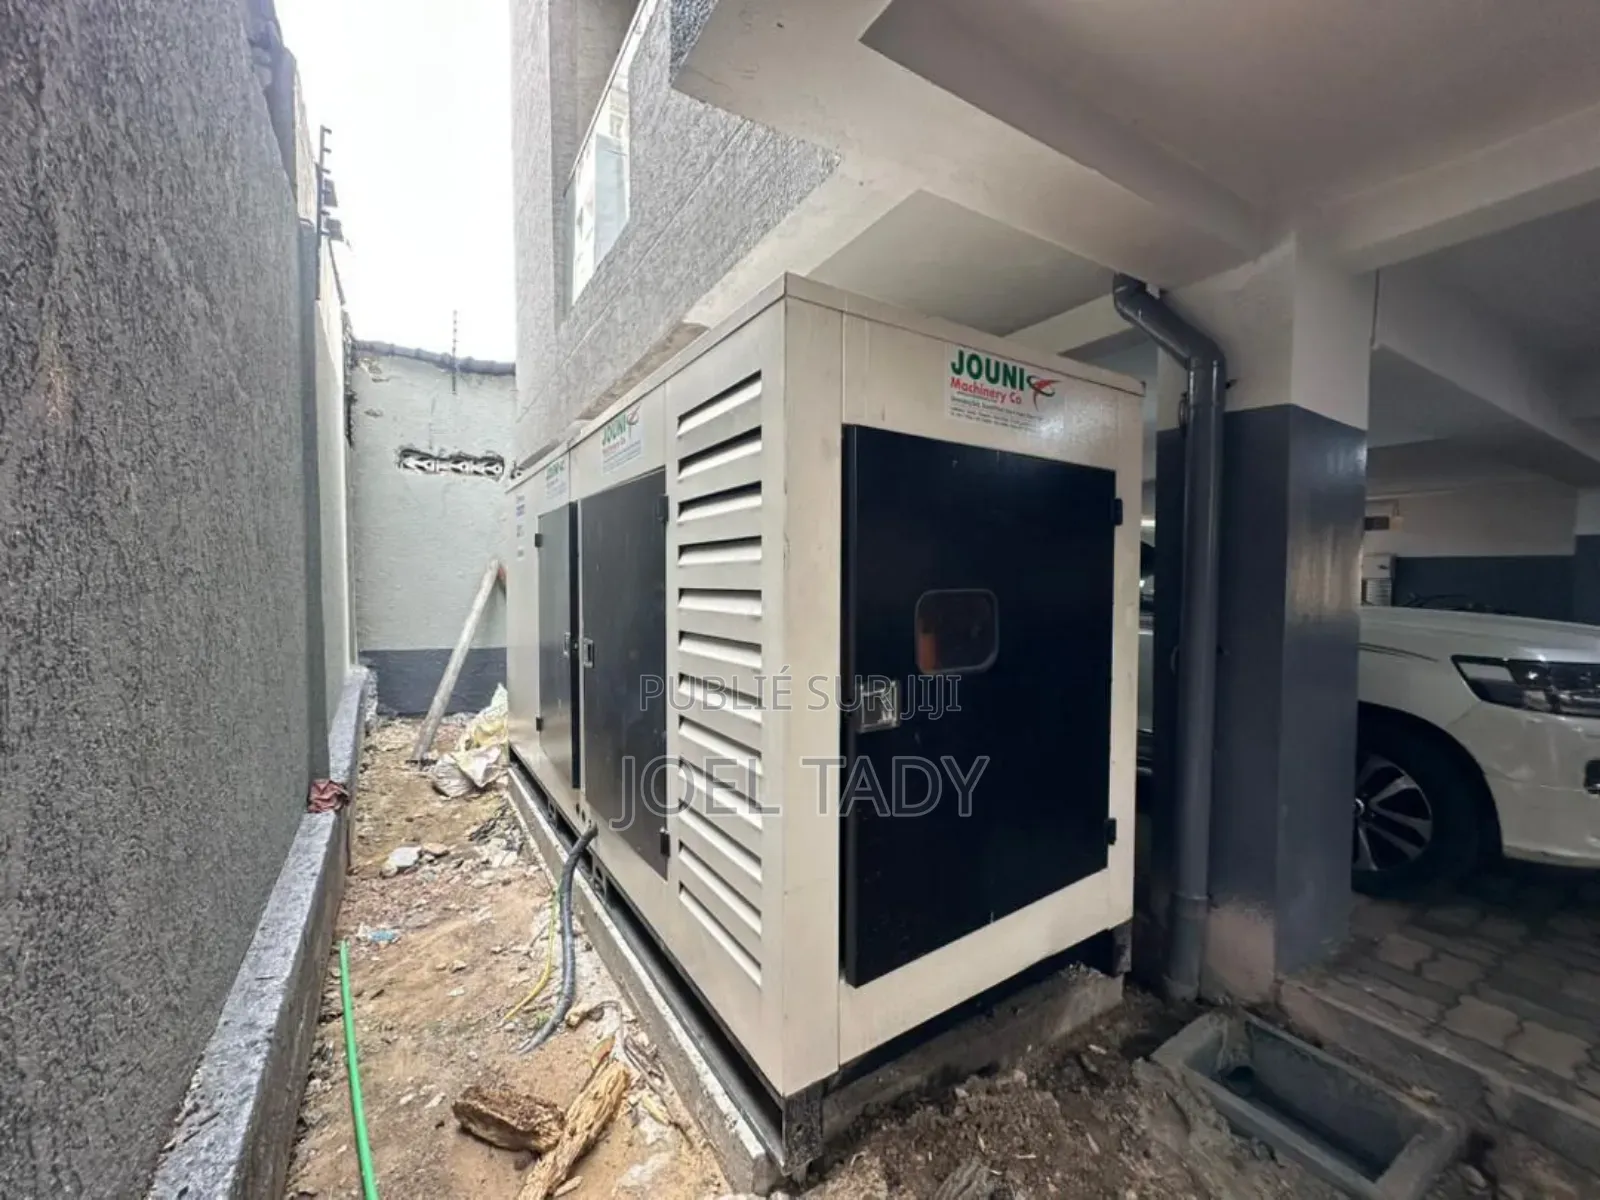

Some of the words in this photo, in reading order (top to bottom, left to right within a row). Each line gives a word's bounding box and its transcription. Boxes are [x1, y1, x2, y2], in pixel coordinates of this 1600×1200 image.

[950, 349, 1025, 391] JOUNI
[950, 376, 1007, 404] Machinery
[1009, 391, 1022, 405] Co
